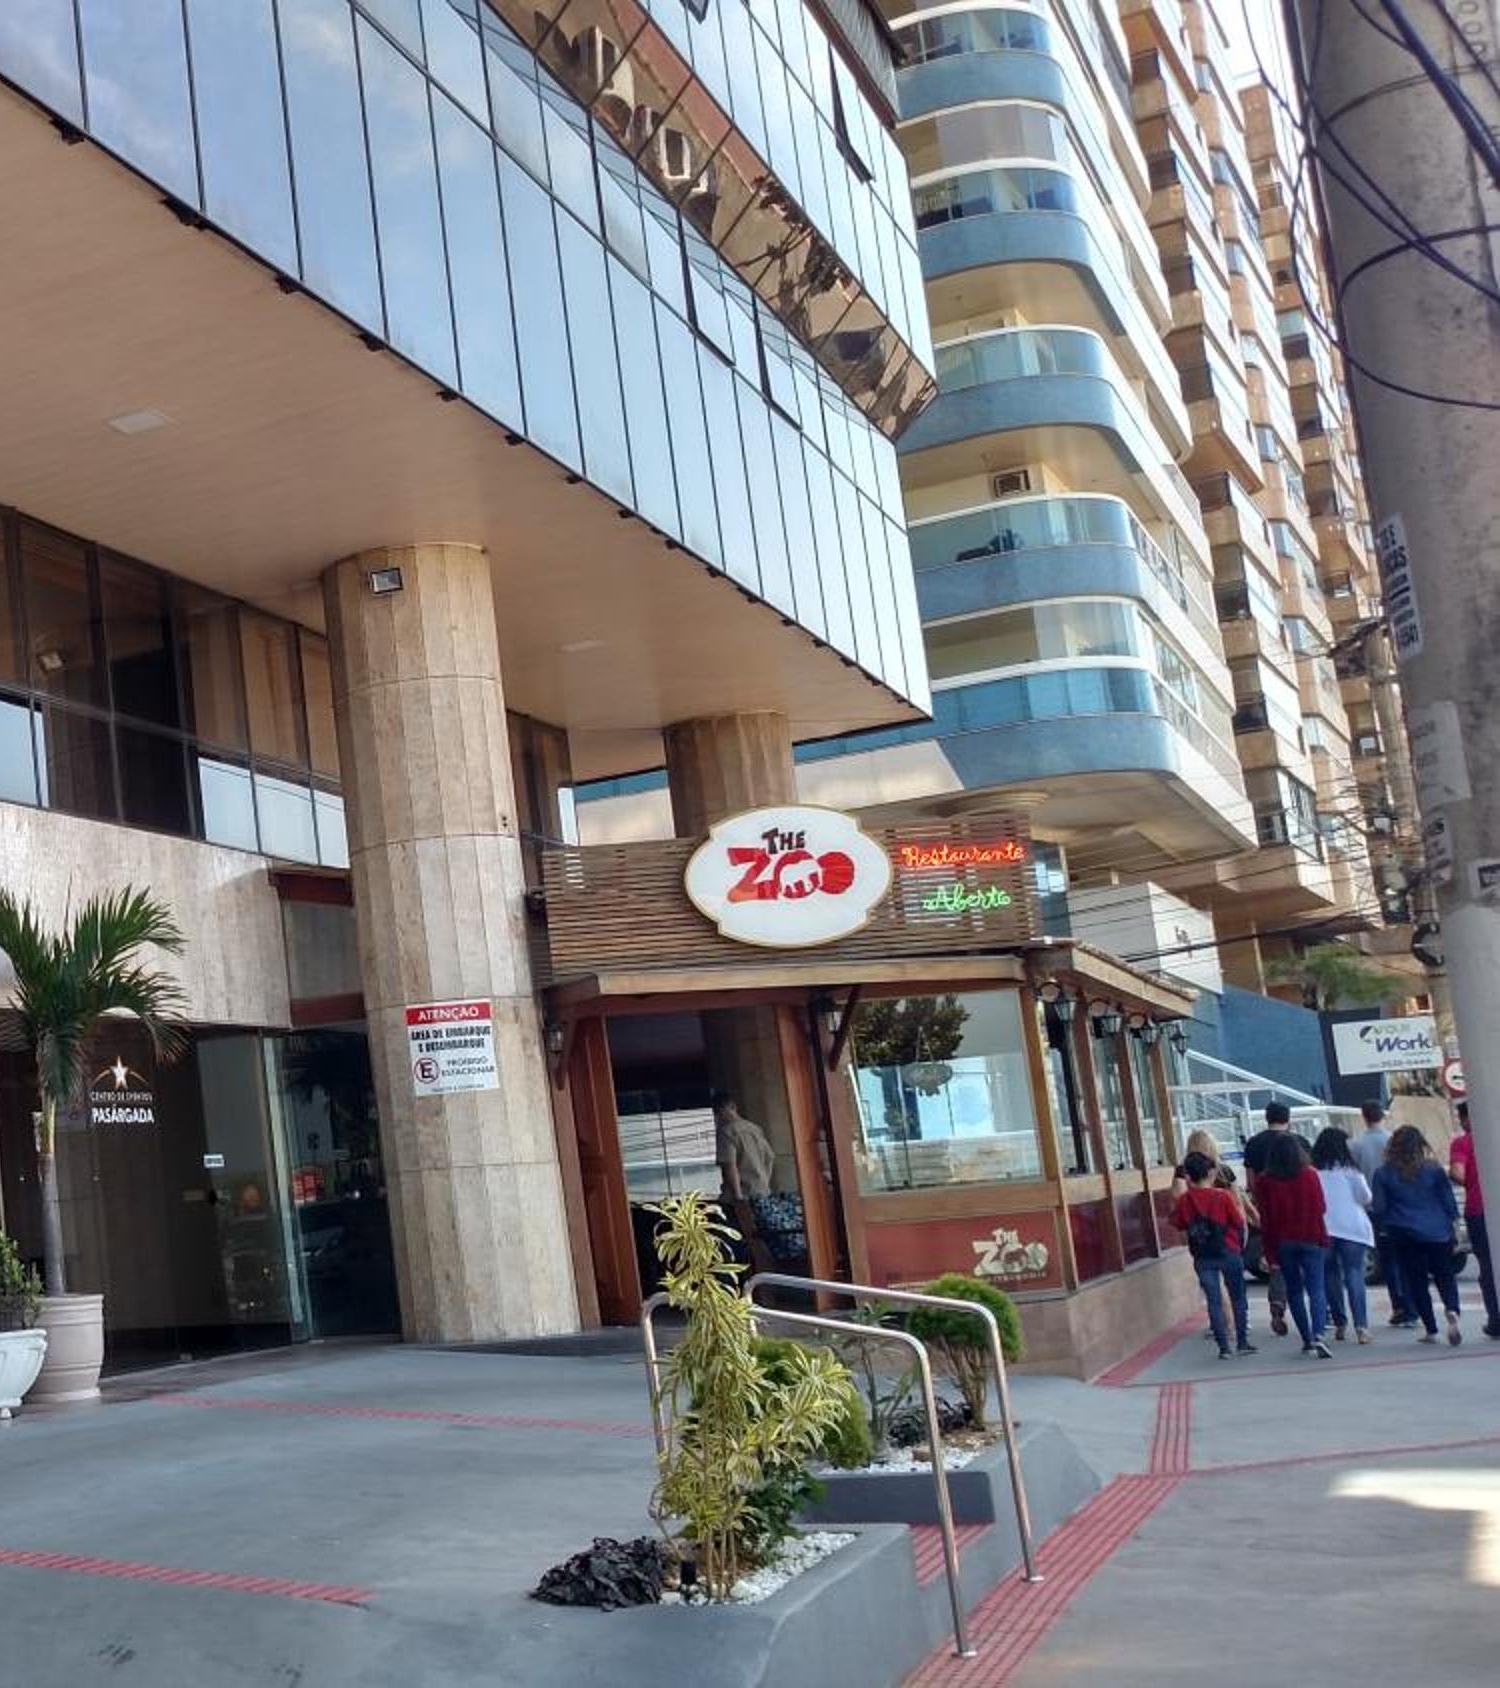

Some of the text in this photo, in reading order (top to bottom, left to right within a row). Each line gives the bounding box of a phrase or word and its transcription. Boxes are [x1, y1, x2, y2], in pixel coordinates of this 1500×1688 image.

[761, 827, 805, 855] THE
[901, 841, 1025, 867] Restaurante
[727, 847, 855, 904] ZOO
[922, 883, 1012, 912] Aberto
[1375, 1033, 1431, 1052] Work
[92, 1103, 155, 1123] PASÁRGADA
